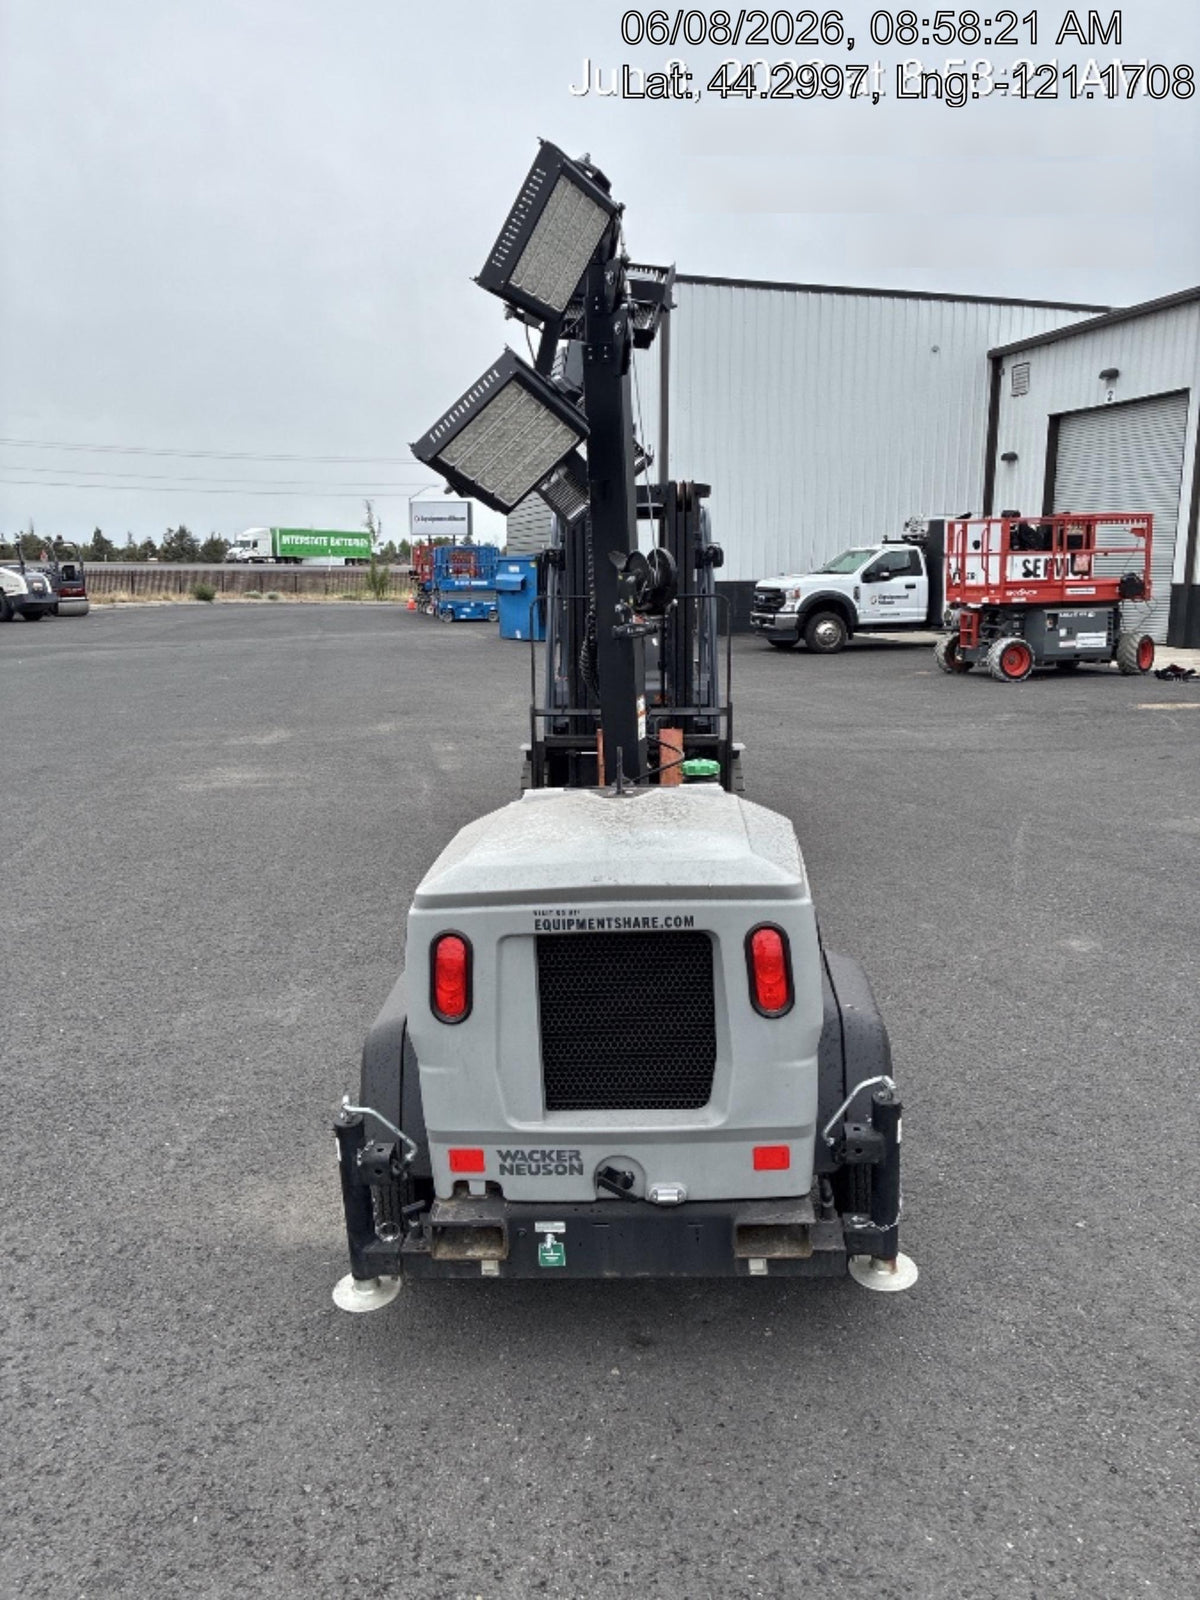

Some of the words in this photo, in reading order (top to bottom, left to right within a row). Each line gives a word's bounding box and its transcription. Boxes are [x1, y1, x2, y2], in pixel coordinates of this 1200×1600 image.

[534, 915, 694, 932] EQUIPMENTSHARE.COM
[496, 1149, 581, 1163] WACKER
[499, 1163, 584, 1176] NEUSON
